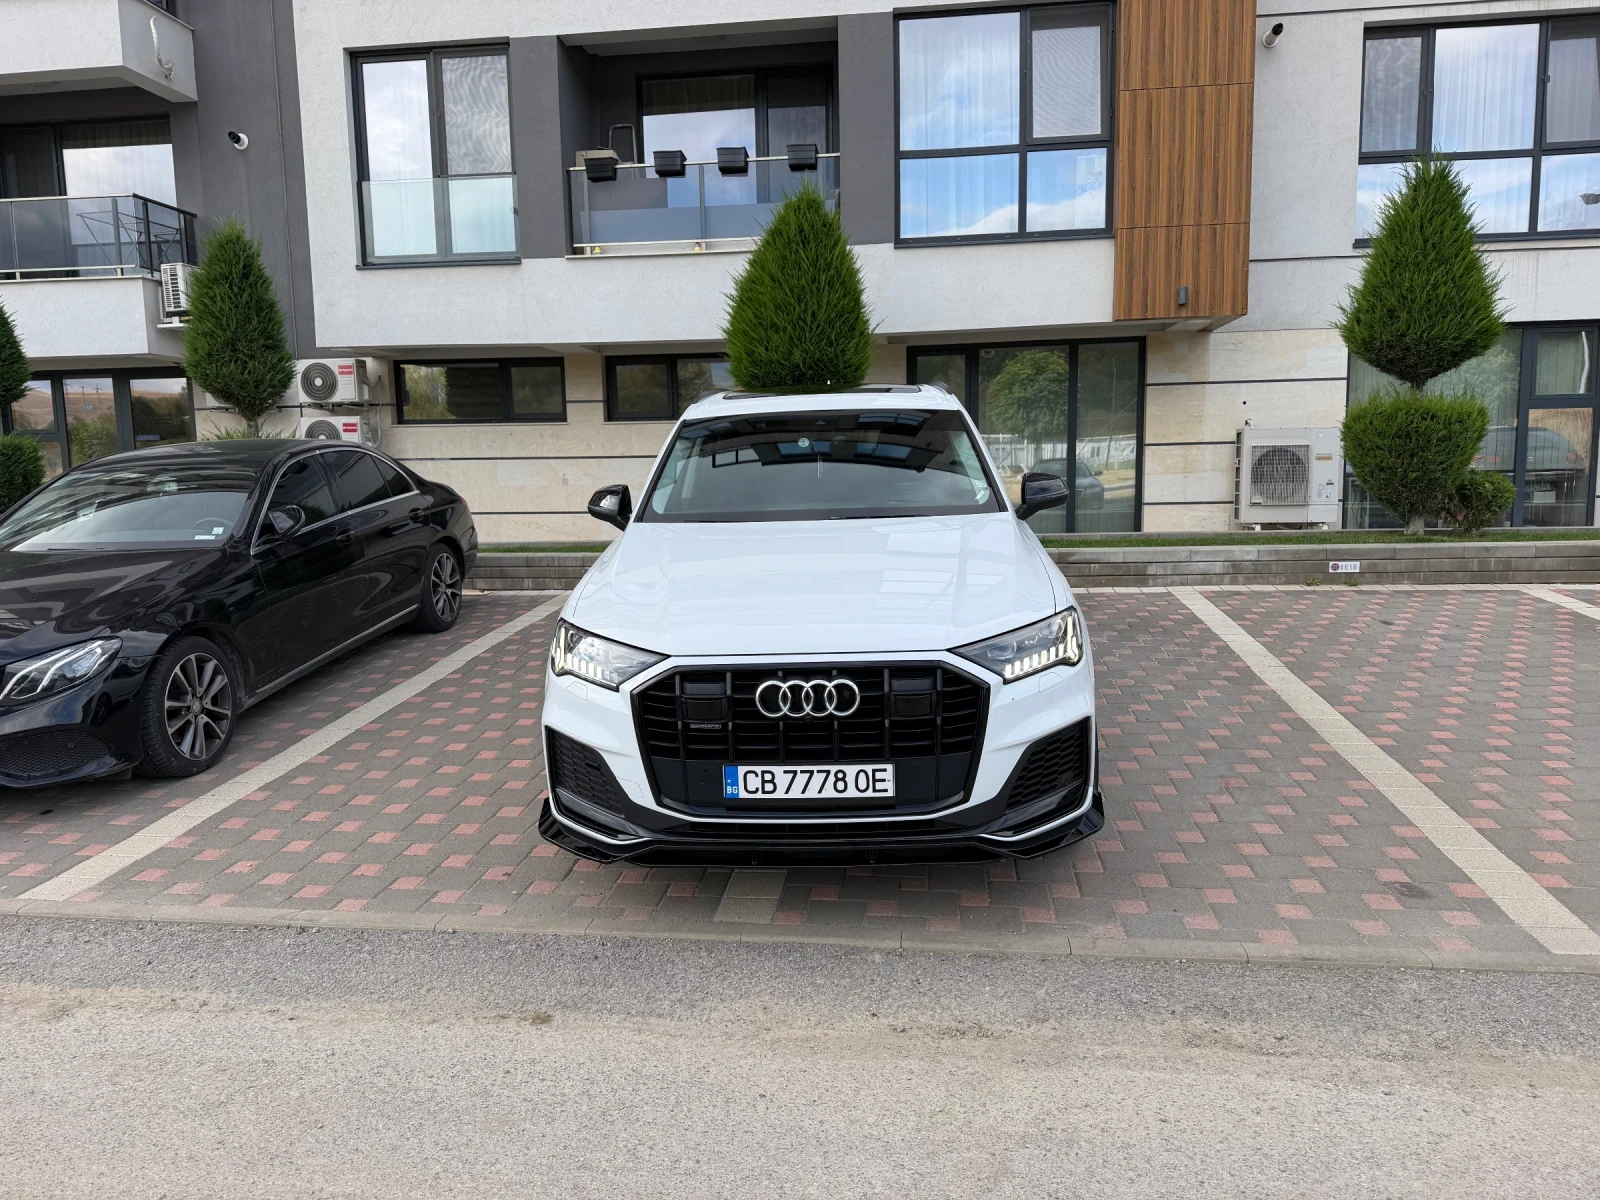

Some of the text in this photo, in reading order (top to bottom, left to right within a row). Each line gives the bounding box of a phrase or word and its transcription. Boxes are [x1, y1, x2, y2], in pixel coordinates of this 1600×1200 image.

[726, 786, 738, 794] BG
[743, 769, 778, 795] CB
[782, 768, 848, 795] 7778
